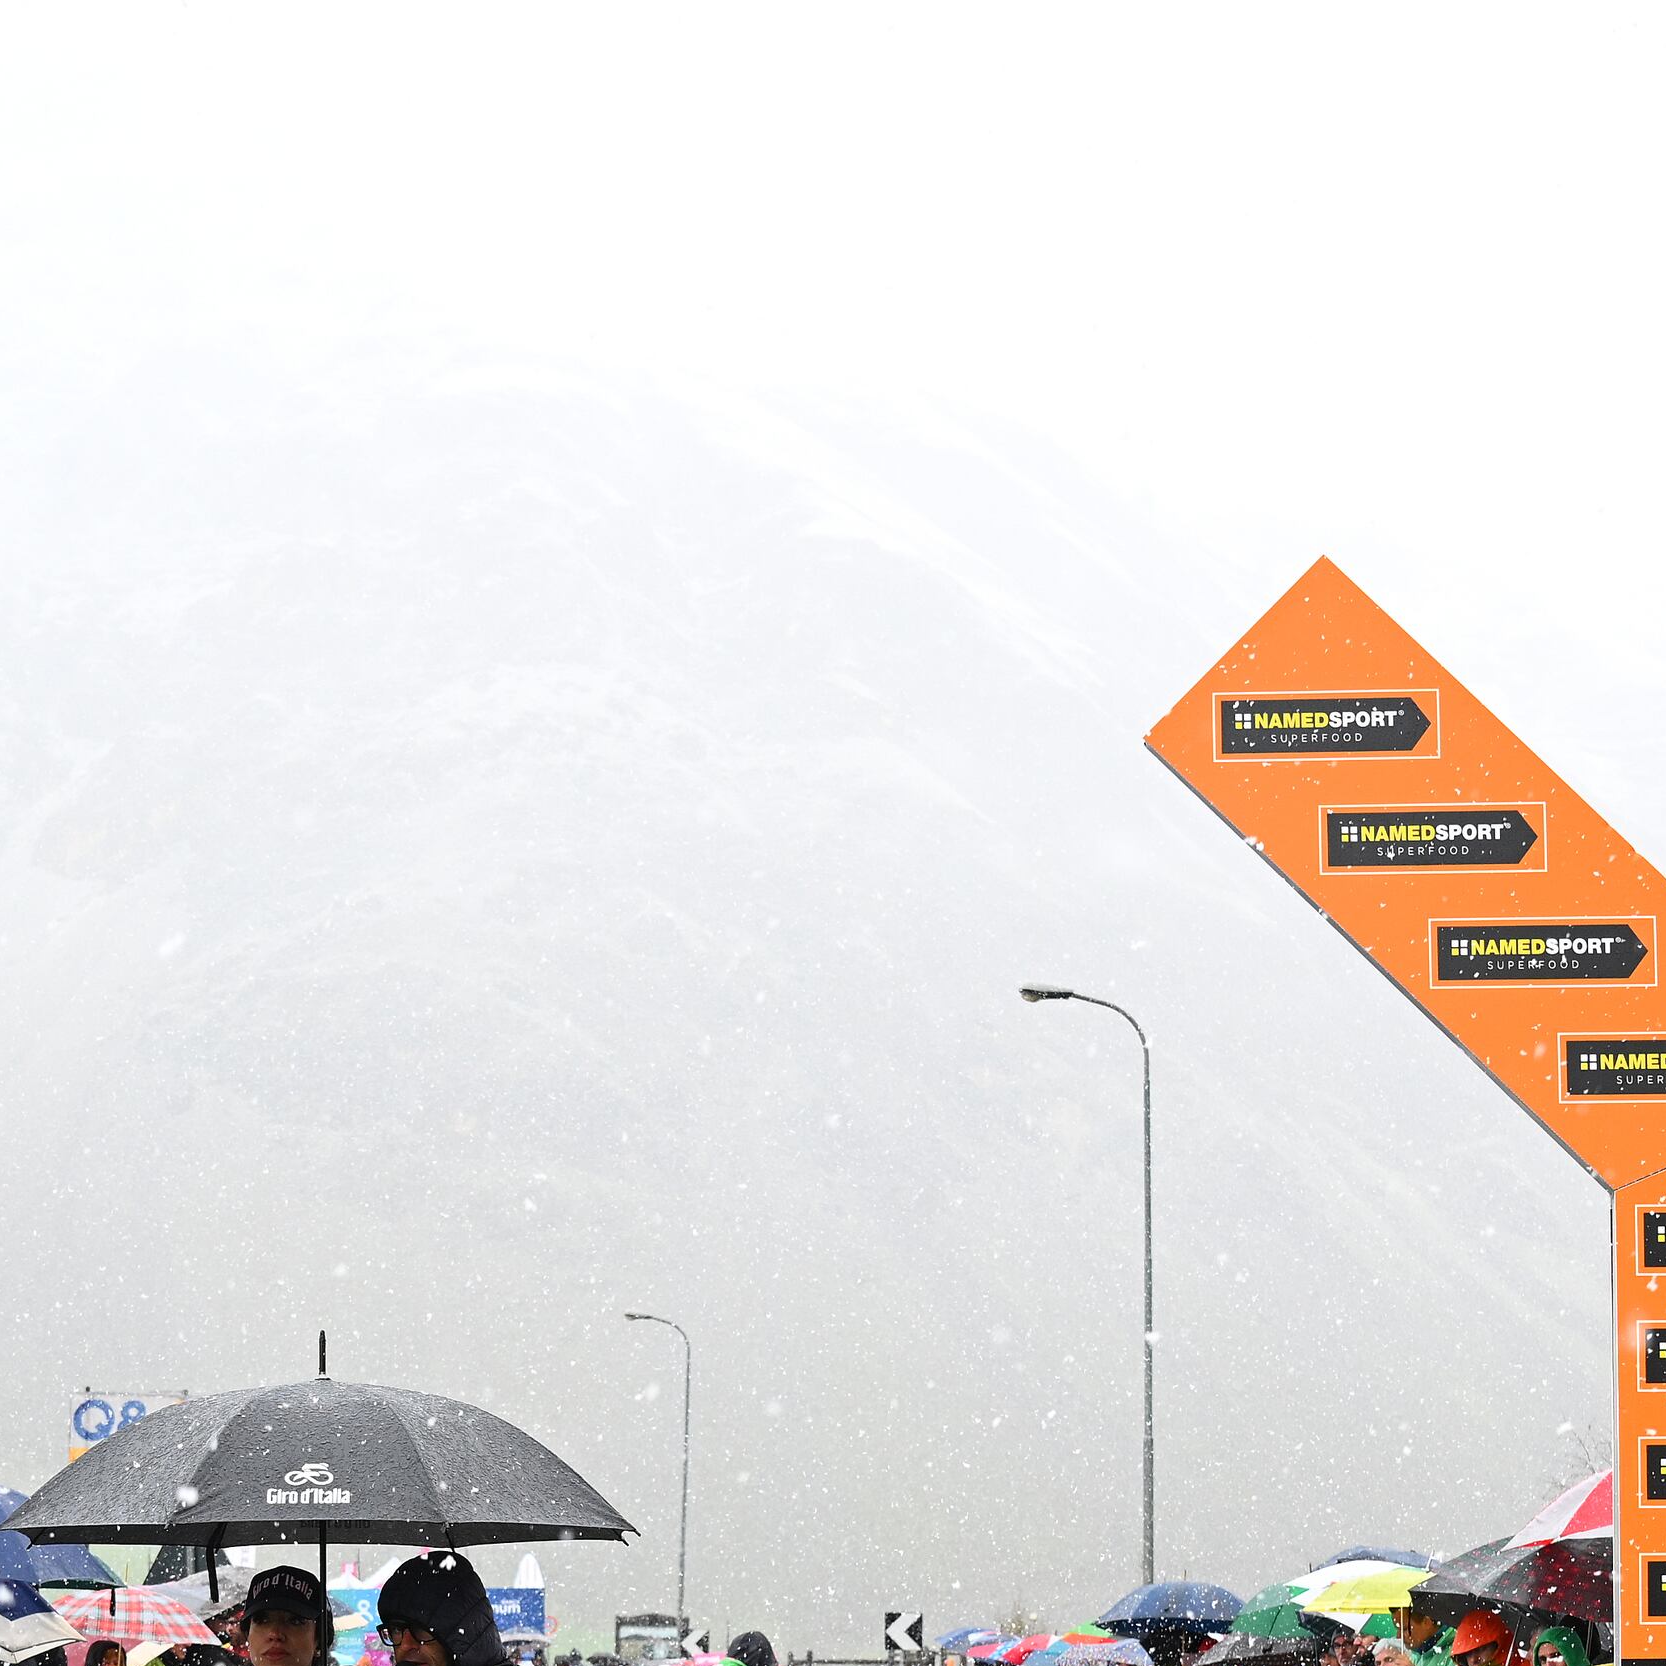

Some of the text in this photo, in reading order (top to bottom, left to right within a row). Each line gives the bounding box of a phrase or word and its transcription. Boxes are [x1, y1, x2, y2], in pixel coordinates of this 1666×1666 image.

[1270, 731, 1363, 743] SUPERFOOD
[1376, 845, 1470, 857] SUPERFOOD
[1486, 958, 1580, 971] SUPERFOOD
[266, 1487, 351, 1504] Giro d'Italia
